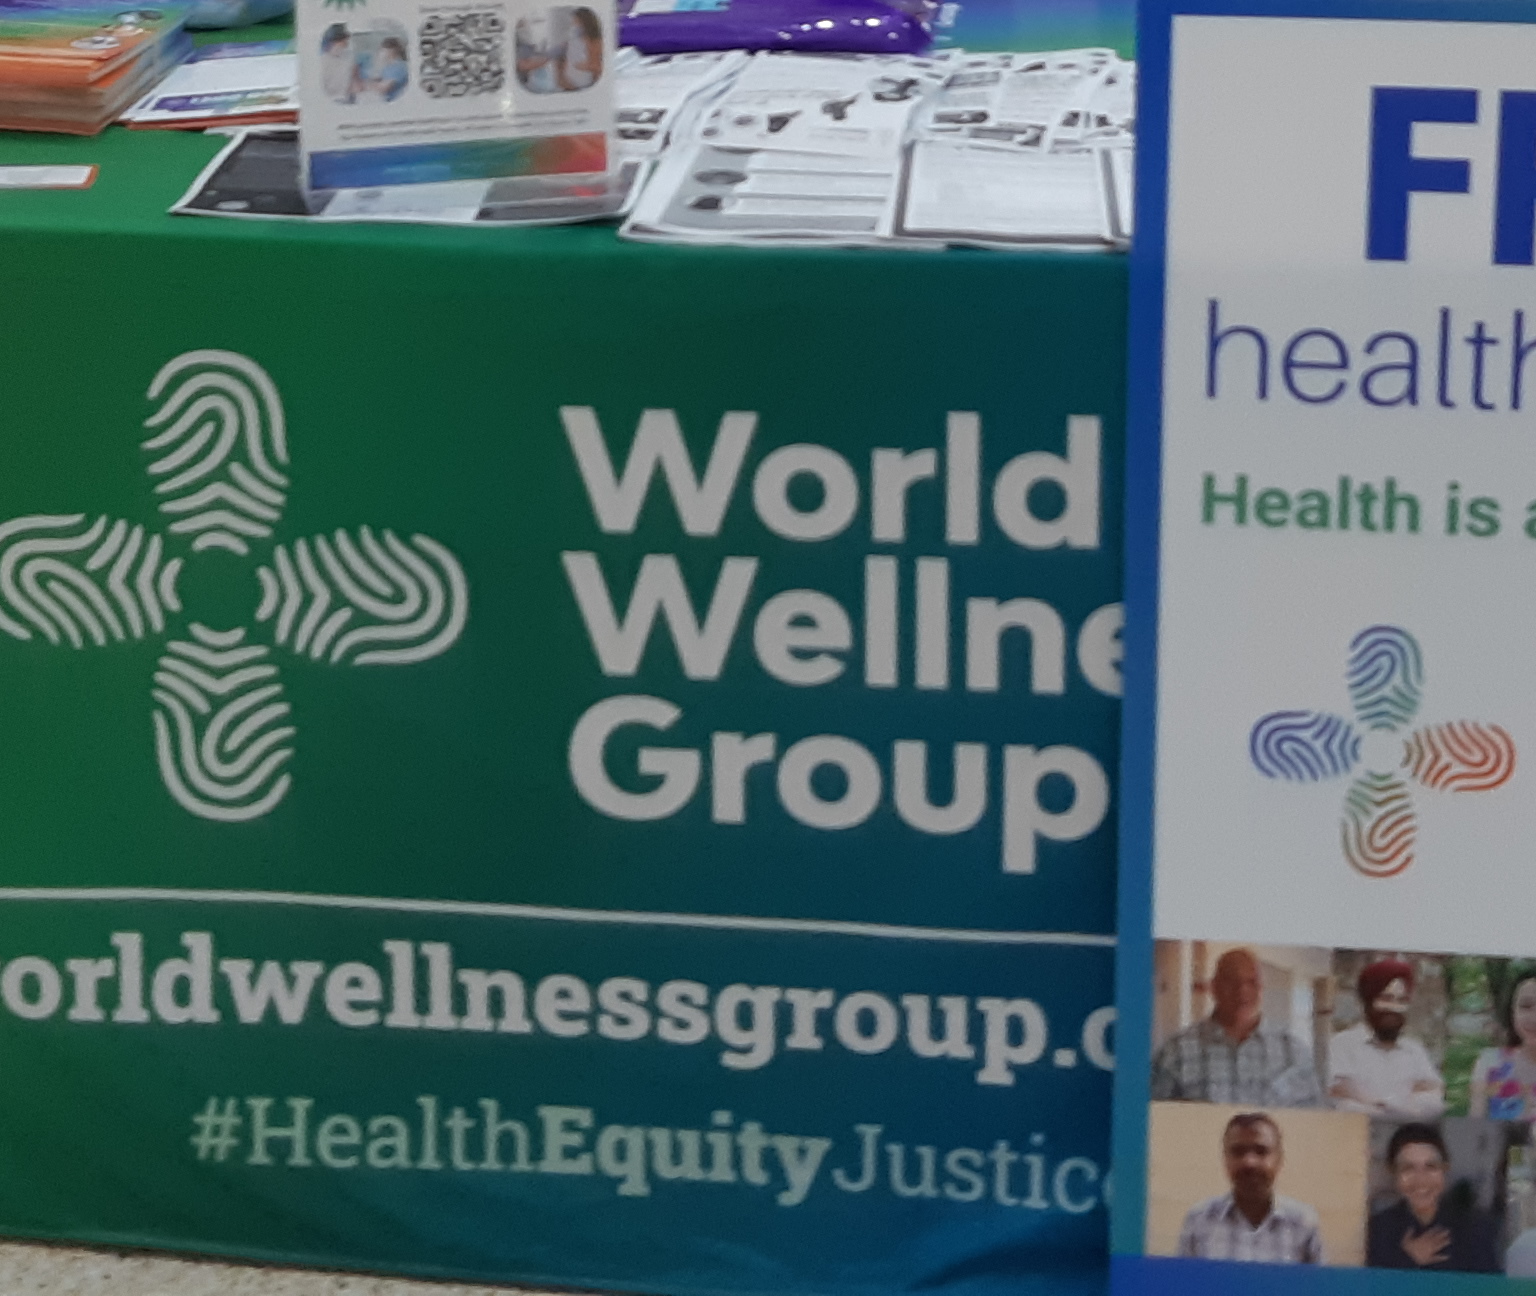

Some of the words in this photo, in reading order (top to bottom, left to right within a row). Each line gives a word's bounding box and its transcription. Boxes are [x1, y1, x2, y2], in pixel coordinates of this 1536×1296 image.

[558, 404, 1103, 550] World
[1200, 472, 1421, 534] Health
[1445, 482, 1501, 538] is
[568, 693, 1110, 875] Group
[189, 1094, 1113, 1215] #HealthEquityJustic
